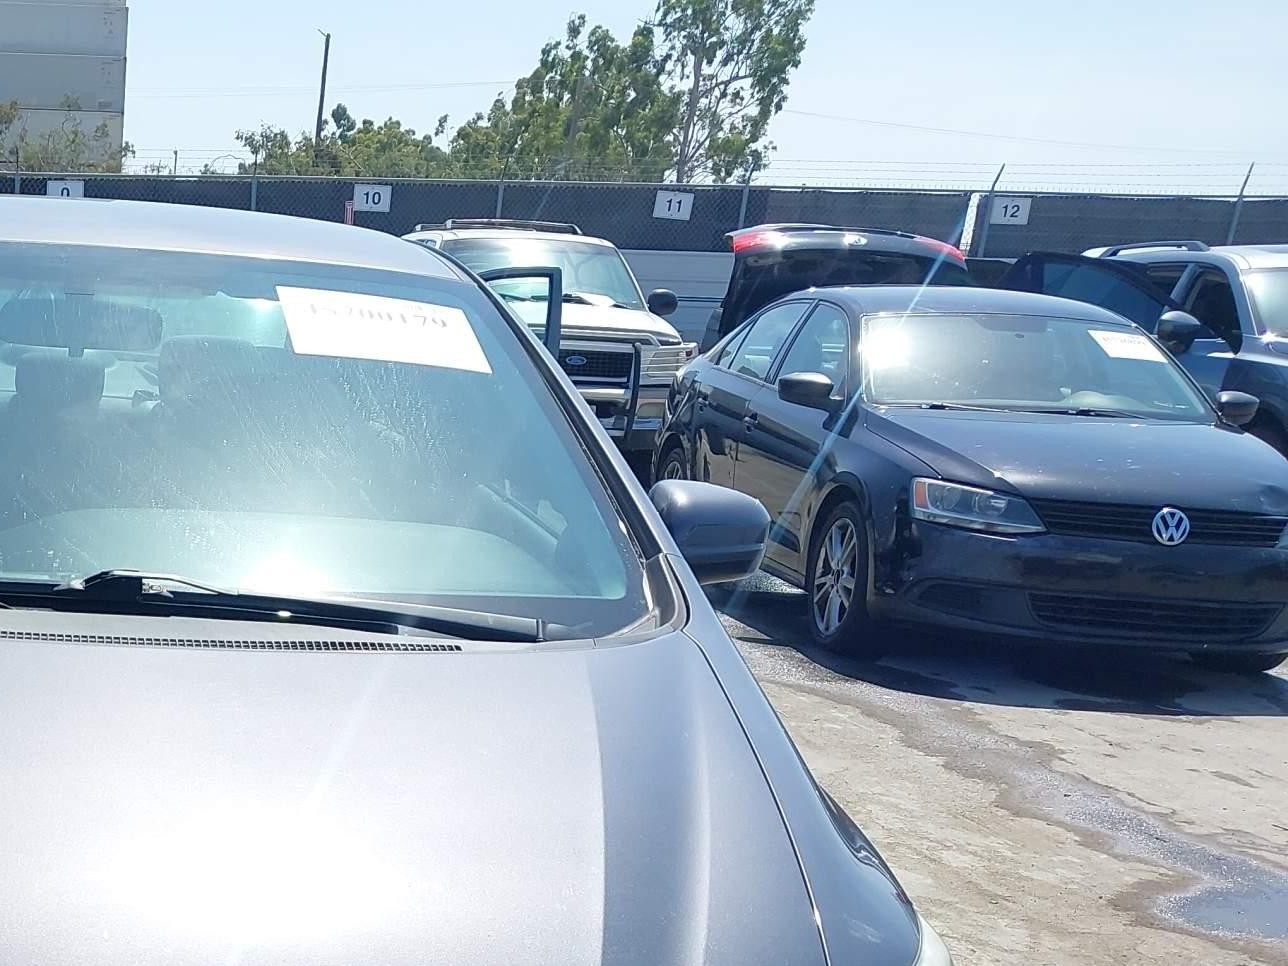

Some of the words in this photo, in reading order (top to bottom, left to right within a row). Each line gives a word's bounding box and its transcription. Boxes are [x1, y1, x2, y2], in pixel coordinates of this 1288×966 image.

[363, 191, 382, 205] 10
[666, 198, 682, 213] 11
[1002, 204, 1021, 218] 12
